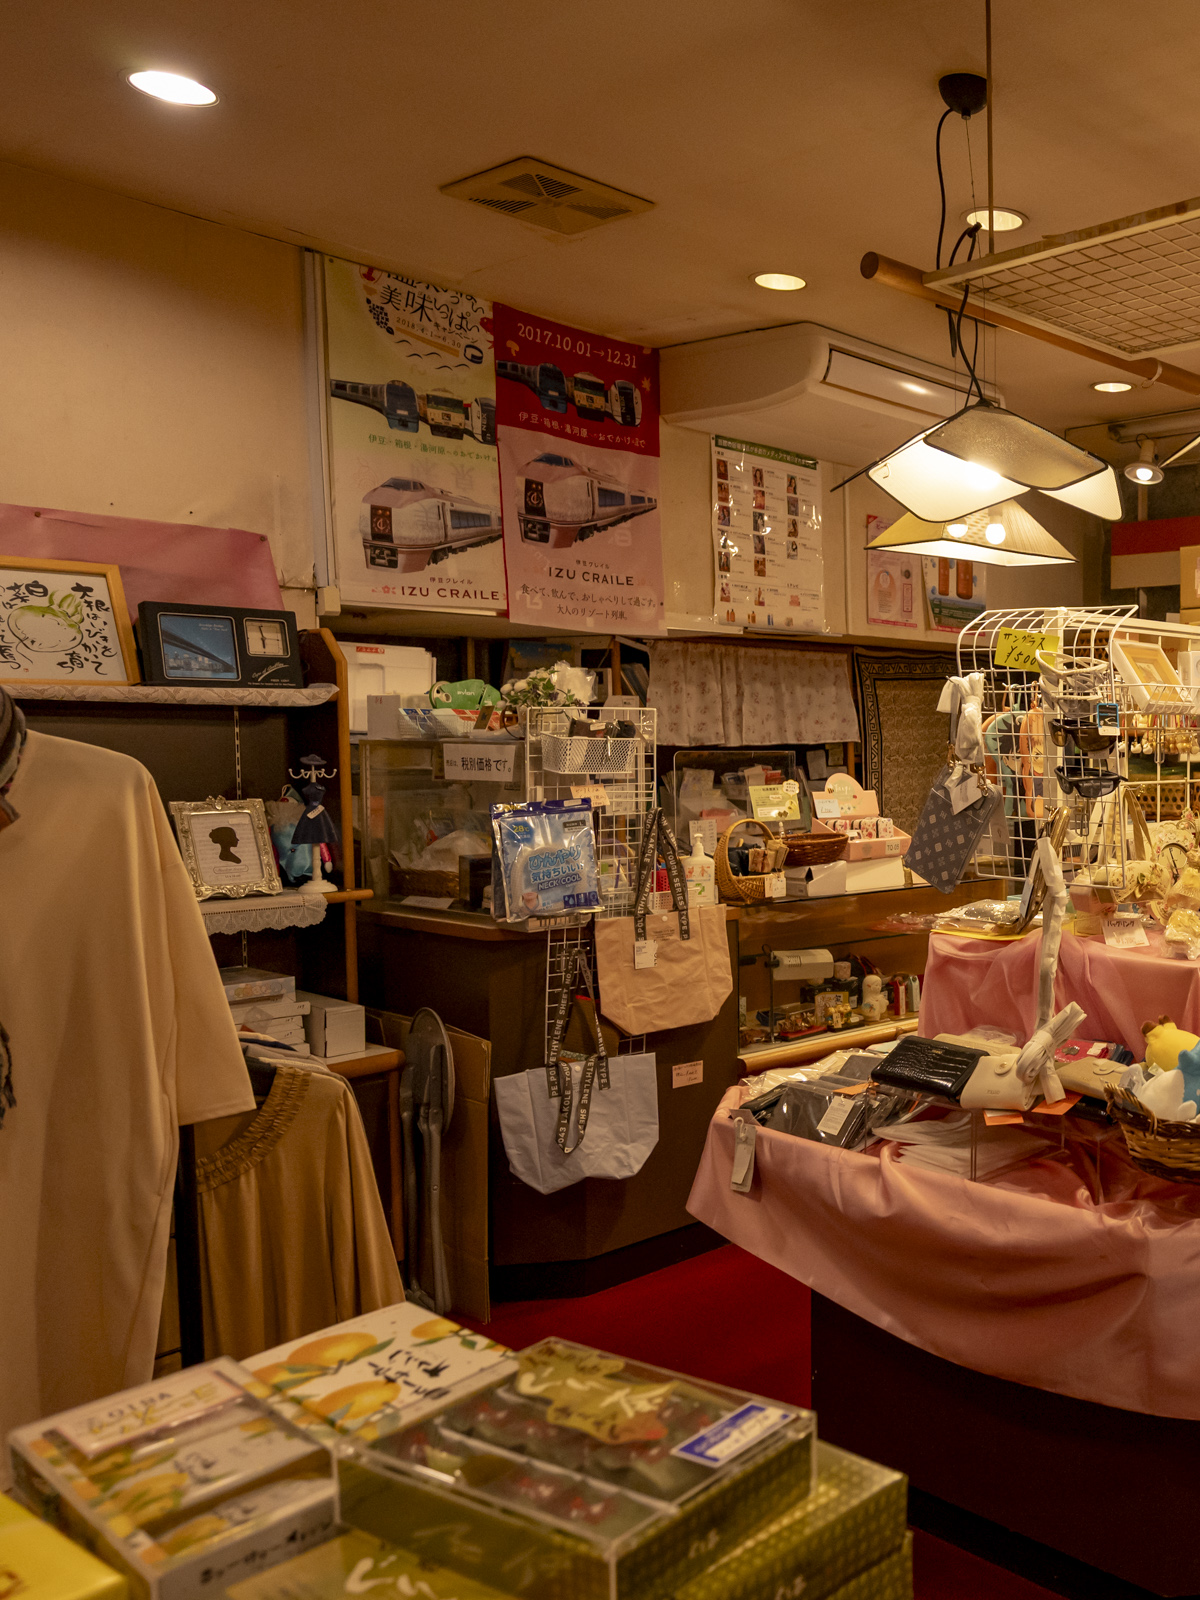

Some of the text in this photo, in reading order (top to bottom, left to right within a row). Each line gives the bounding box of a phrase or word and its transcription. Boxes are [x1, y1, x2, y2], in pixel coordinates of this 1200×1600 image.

[548, 566, 635, 586] IZU CRAILE
[401, 585, 500, 600] IZU CRAILE
[529, 845, 582, 871] ひんやり
[538, 873, 582, 891] NECK COOL
[559, 988, 569, 1015] SHEET
[561, 1090, 572, 1124] LAKOLE
